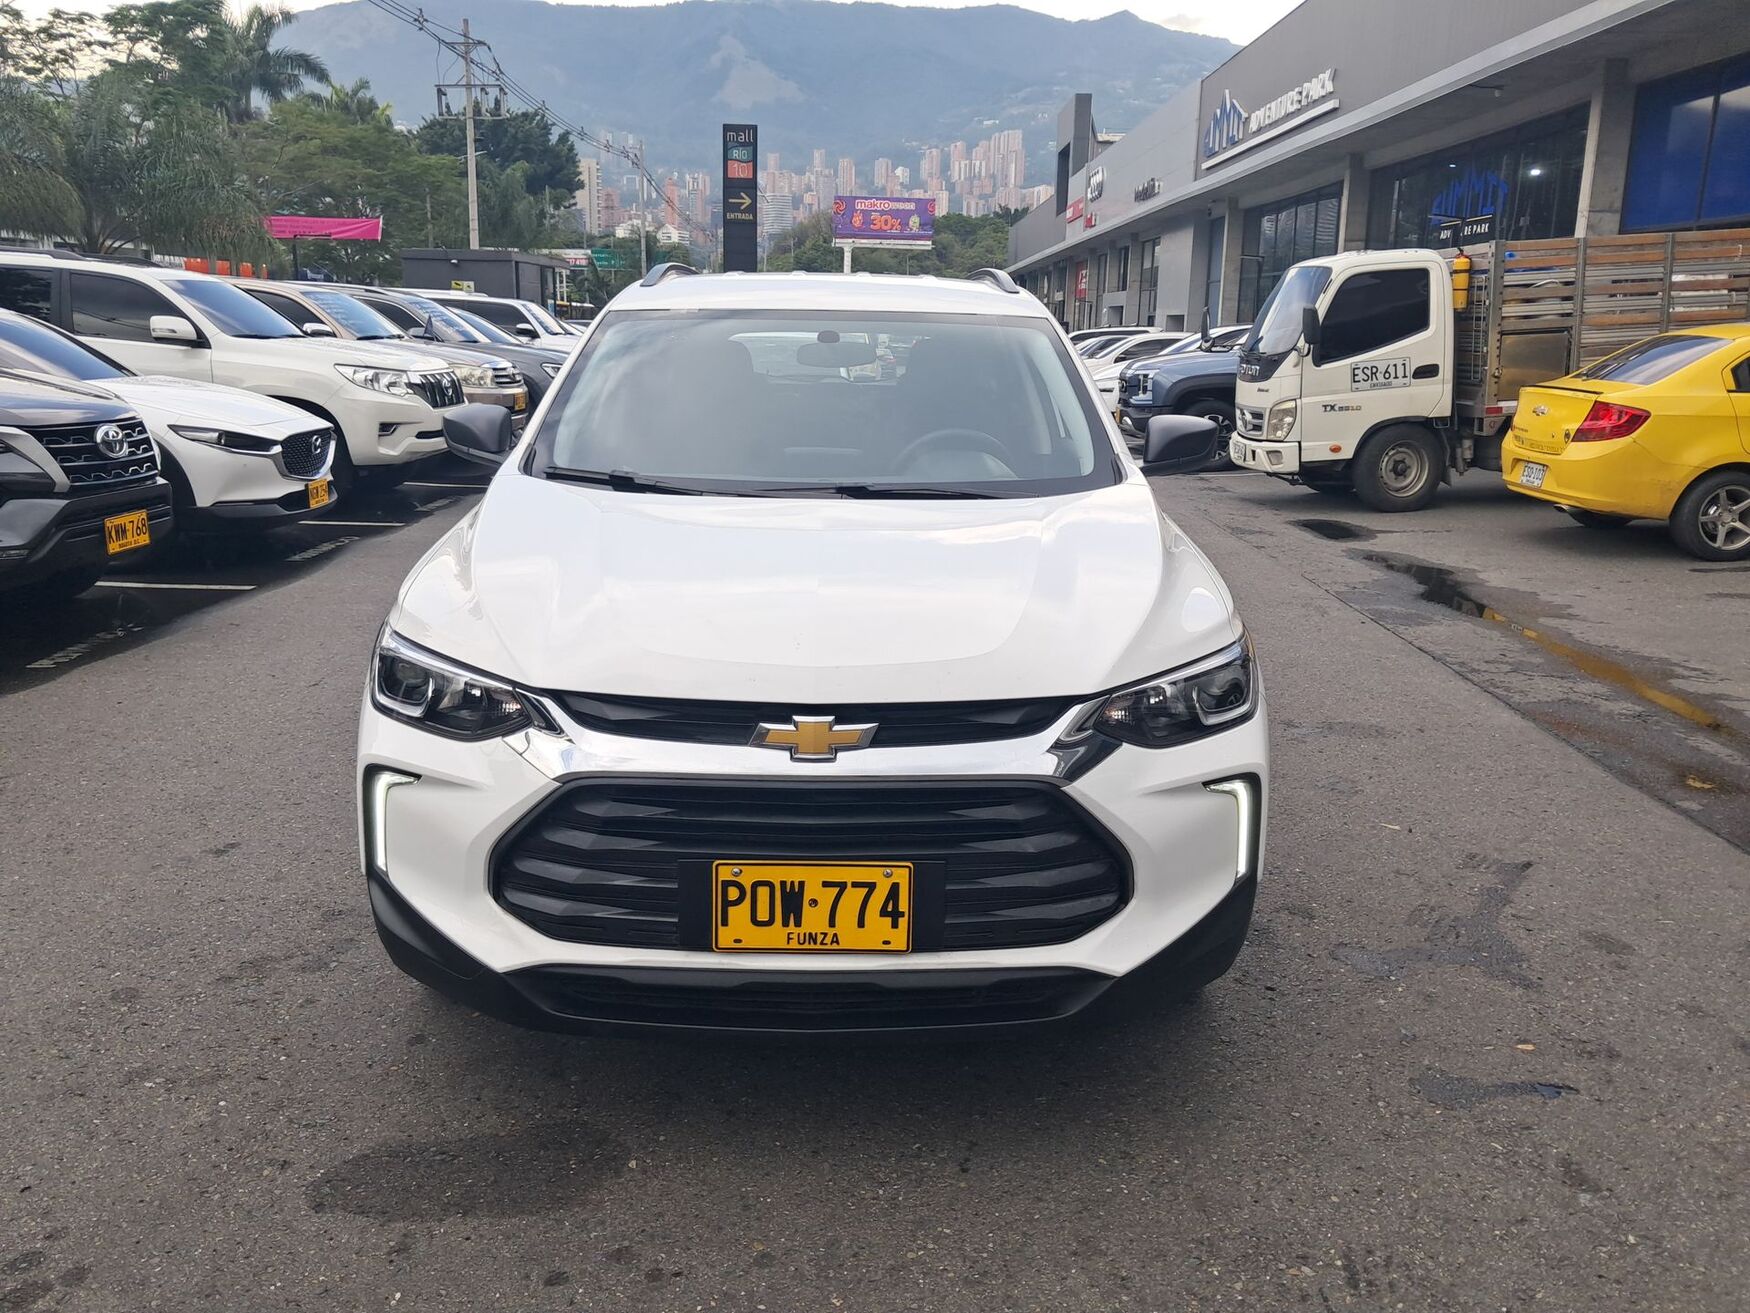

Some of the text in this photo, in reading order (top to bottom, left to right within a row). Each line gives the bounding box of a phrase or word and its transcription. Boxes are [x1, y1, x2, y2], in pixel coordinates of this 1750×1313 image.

[1301, 68, 1336, 106] PARK
[726, 129, 754, 143] mall
[732, 163, 748, 177] 10
[726, 212, 754, 220] ENTRADA
[870, 214, 902, 231] 30%
[1472, 223, 1490, 234] PARK
[786, 932, 841, 946] FUNZA
